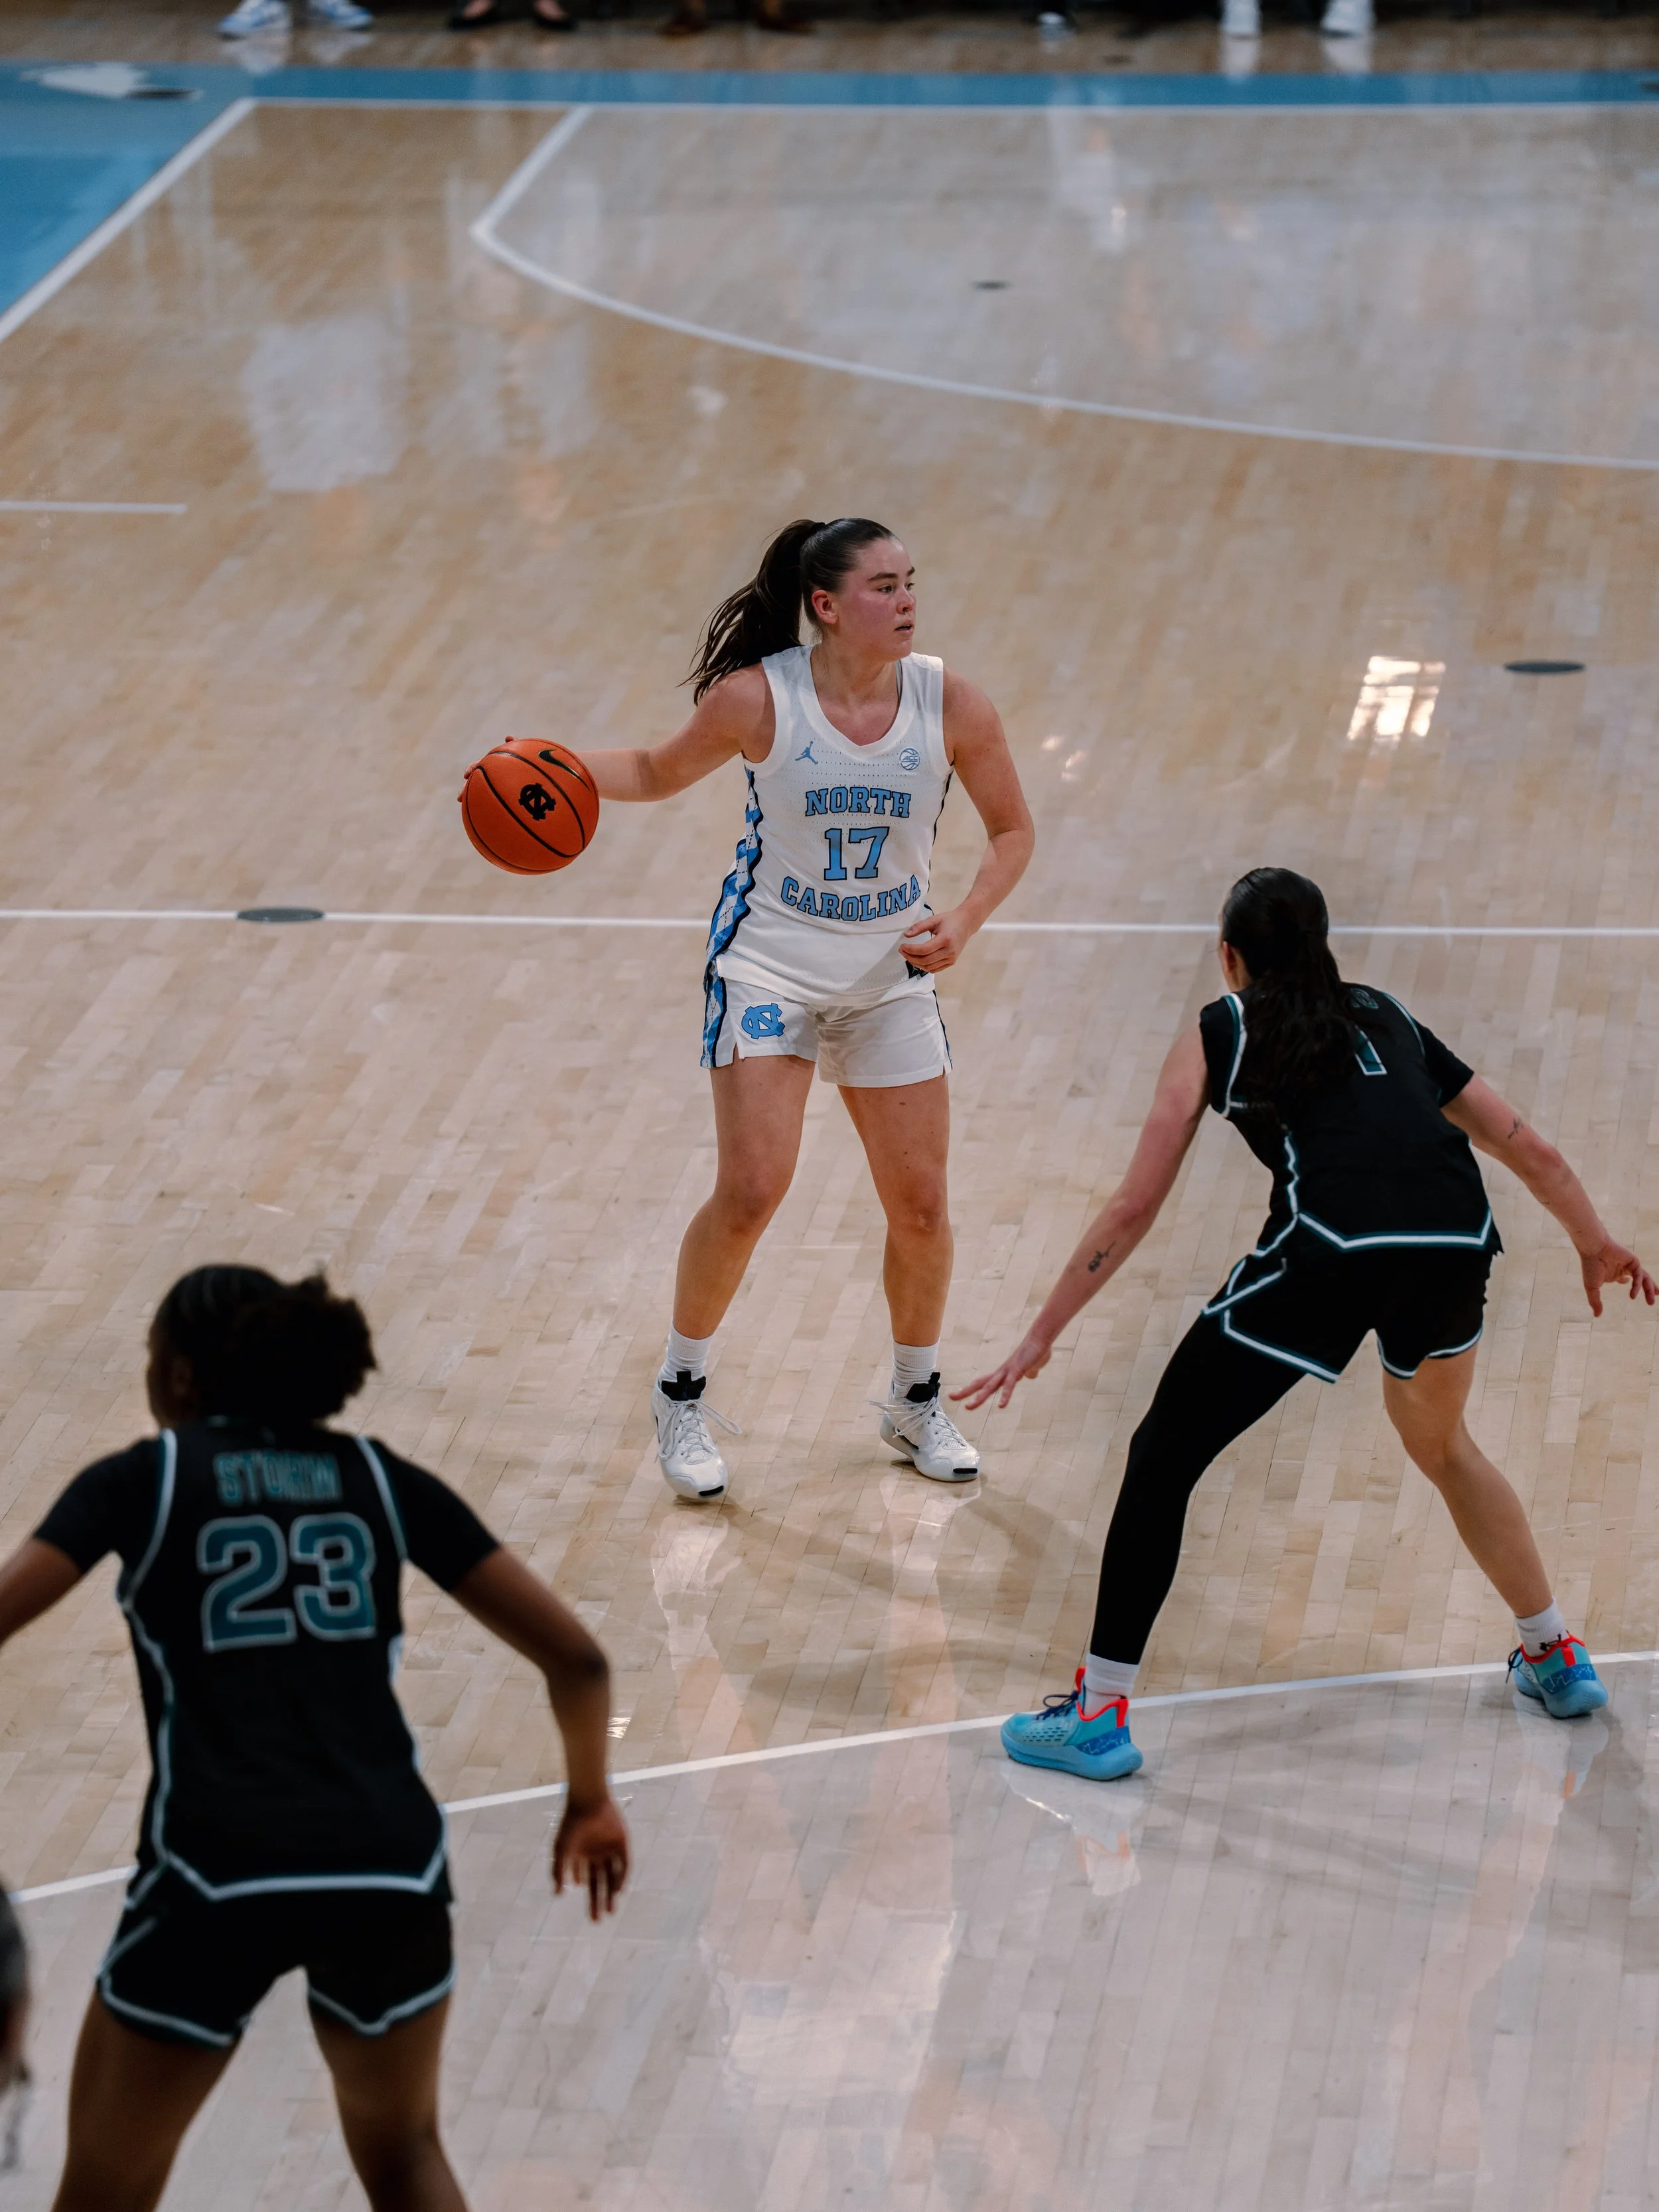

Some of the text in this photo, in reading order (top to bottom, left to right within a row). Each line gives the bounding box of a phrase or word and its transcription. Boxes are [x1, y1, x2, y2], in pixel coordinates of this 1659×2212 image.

[805, 786, 911, 818] NORTH
[824, 826, 890, 881] 17
[780, 874, 921, 922] CAROLINA
[196, 1512, 376, 1653] 23
